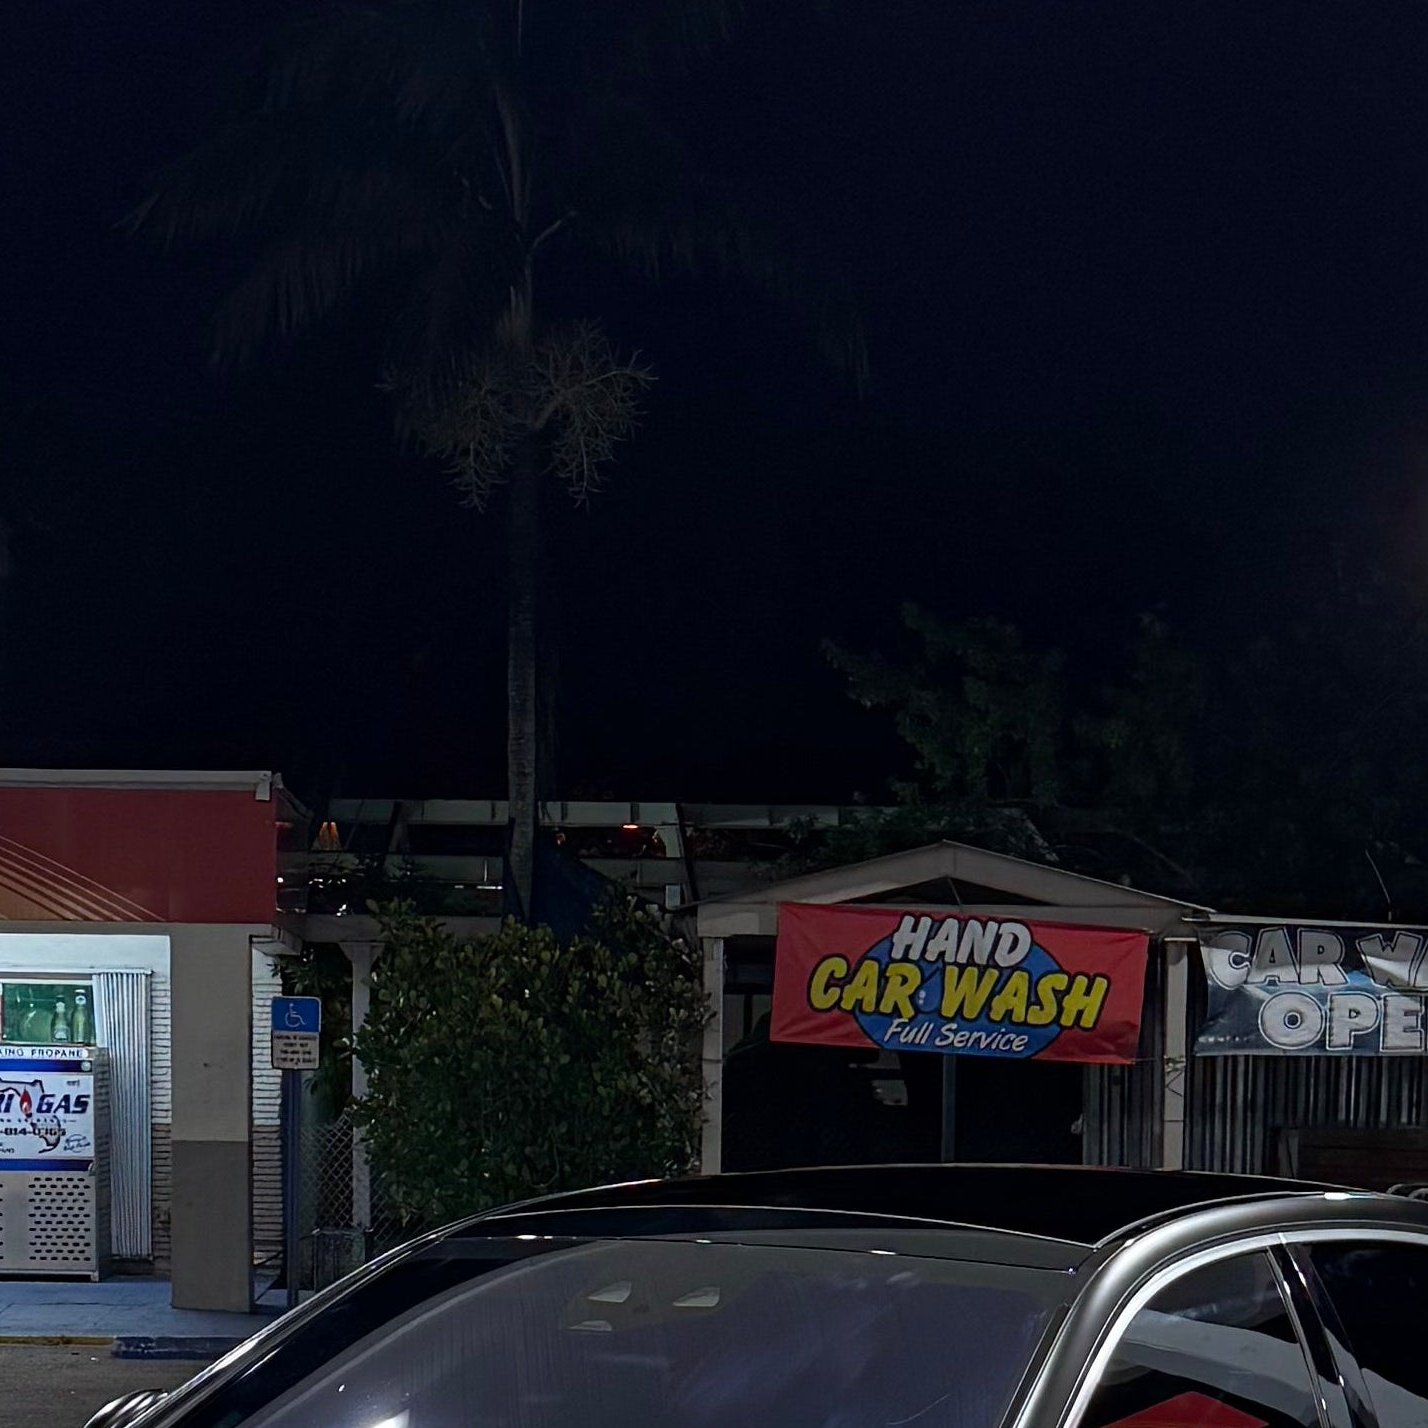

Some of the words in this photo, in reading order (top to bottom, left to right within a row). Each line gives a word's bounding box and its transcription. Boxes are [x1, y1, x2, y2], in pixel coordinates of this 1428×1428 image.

[890, 915, 1033, 968] HAND
[1206, 927, 1349, 991] CAR
[809, 954, 922, 1020] CAR
[939, 963, 1109, 1029] WASH
[30, 1048, 82, 1058] PROPANE
[884, 1017, 932, 1046] Full
[934, 1021, 1029, 1052] Service
[35, 1093, 92, 1115] GAS
